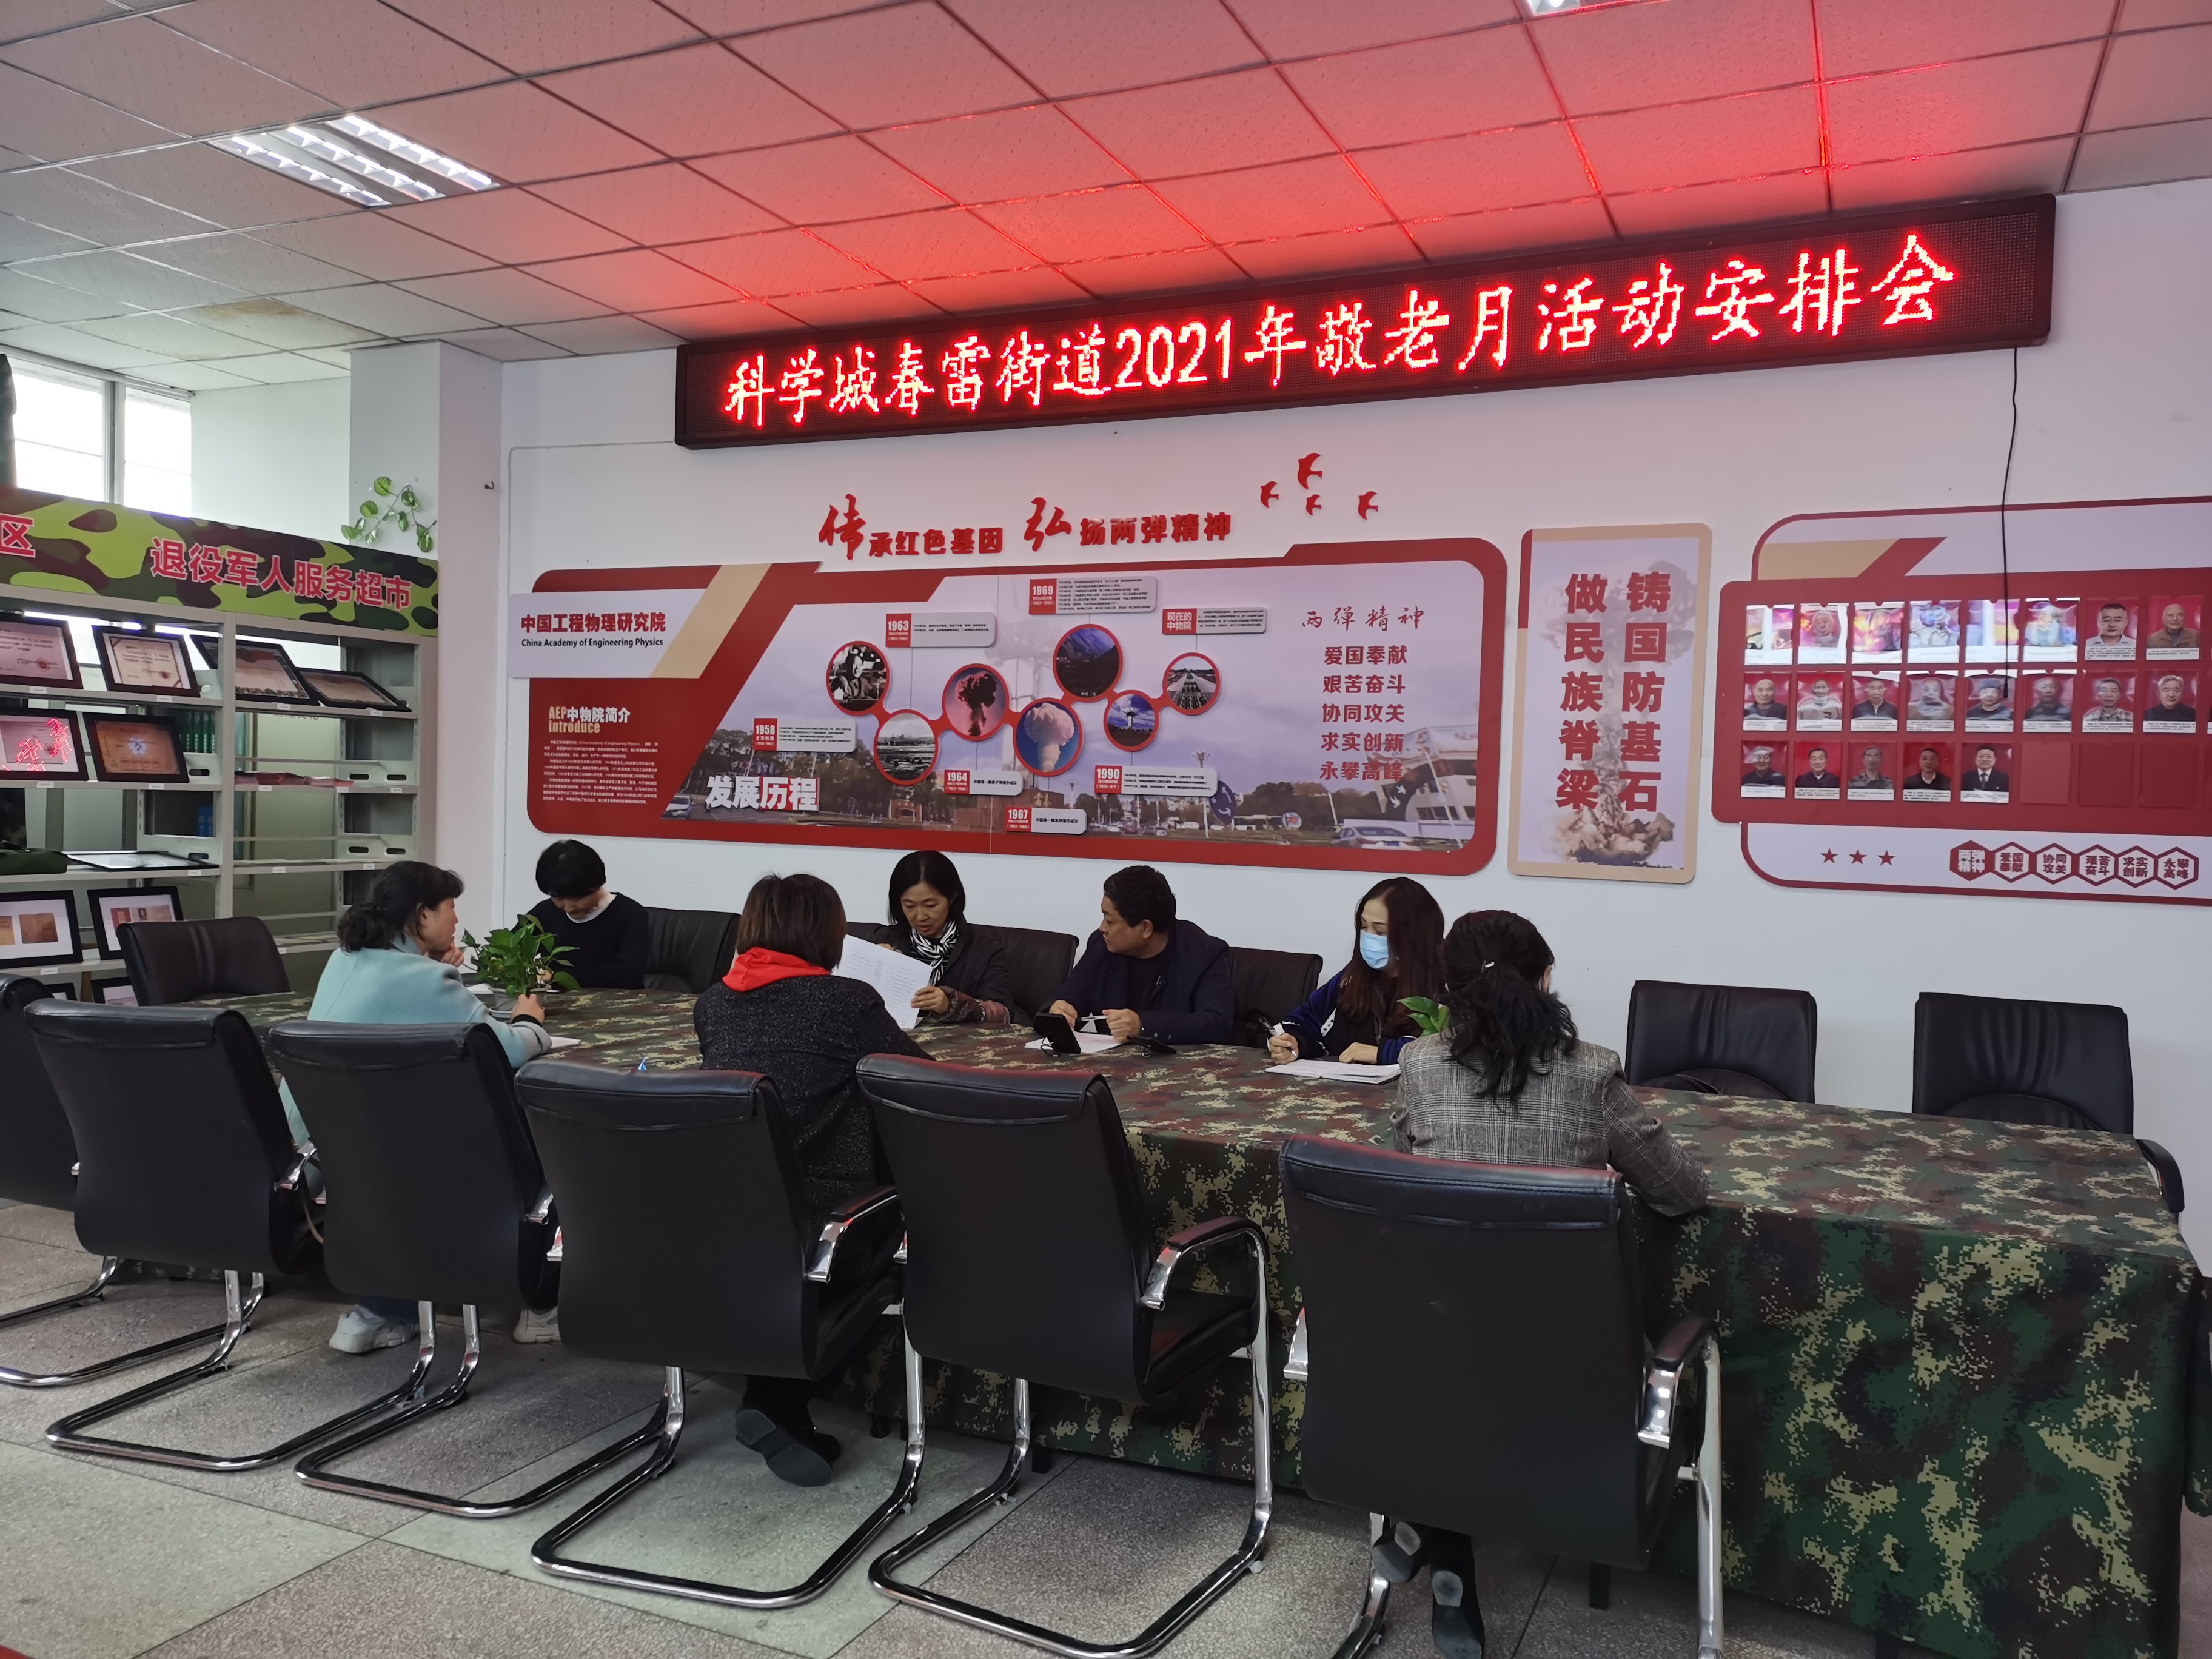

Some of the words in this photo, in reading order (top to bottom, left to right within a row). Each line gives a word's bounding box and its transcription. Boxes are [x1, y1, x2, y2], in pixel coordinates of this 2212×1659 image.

[725, 232, 1956, 427] 科学城春雷街道2021年敬老月活动安排会
[818, 494, 1004, 561] 传承红色基因
[1024, 497, 1232, 552] 弘扬两弹精神
[0, 513, 35, 558] 区
[150, 536, 412, 611] 退役军人服务超市
[1032, 585, 1054, 595] 1969
[521, 612, 666, 633] 中国工程物理研究院
[1167, 612, 1193, 622] 现在的
[1302, 605, 1424, 631] 两弹精神
[888, 620, 910, 631] 1963
[1167, 621, 1193, 631] 中物院
[544, 638, 577, 648] Academy
[589, 638, 633, 648] Engineering
[635, 637, 663, 648] Physics
[1324, 645, 1407, 665] 爱国奉献
[1322, 674, 1406, 694] 艰苦奋斗
[1556, 573, 1608, 810] 做民族脊梁
[1618, 571, 1671, 812] 铸国防基石
[549, 706, 631, 723] AEP中物院简介
[1322, 703, 1404, 723] 协同攻关
[549, 720, 600, 734] introduce
[756, 725, 776, 736] 1958
[1321, 732, 1404, 752] 求实创新
[947, 771, 968, 782] 1964
[1096, 768, 1121, 779] 1990
[1319, 760, 1403, 781] 永攀高峰
[705, 775, 817, 811] 发展历程
[1008, 809, 1028, 819] 1967
[2000, 852, 2024, 862] 爱国
[2043, 853, 2067, 864] 协同
[2085, 855, 2110, 866] 艰苦
[2123, 856, 2148, 866] 求实
[2043, 864, 2066, 874] 攻关
[2085, 865, 2110, 876] 奋斗
[2123, 866, 2148, 877] 创新
